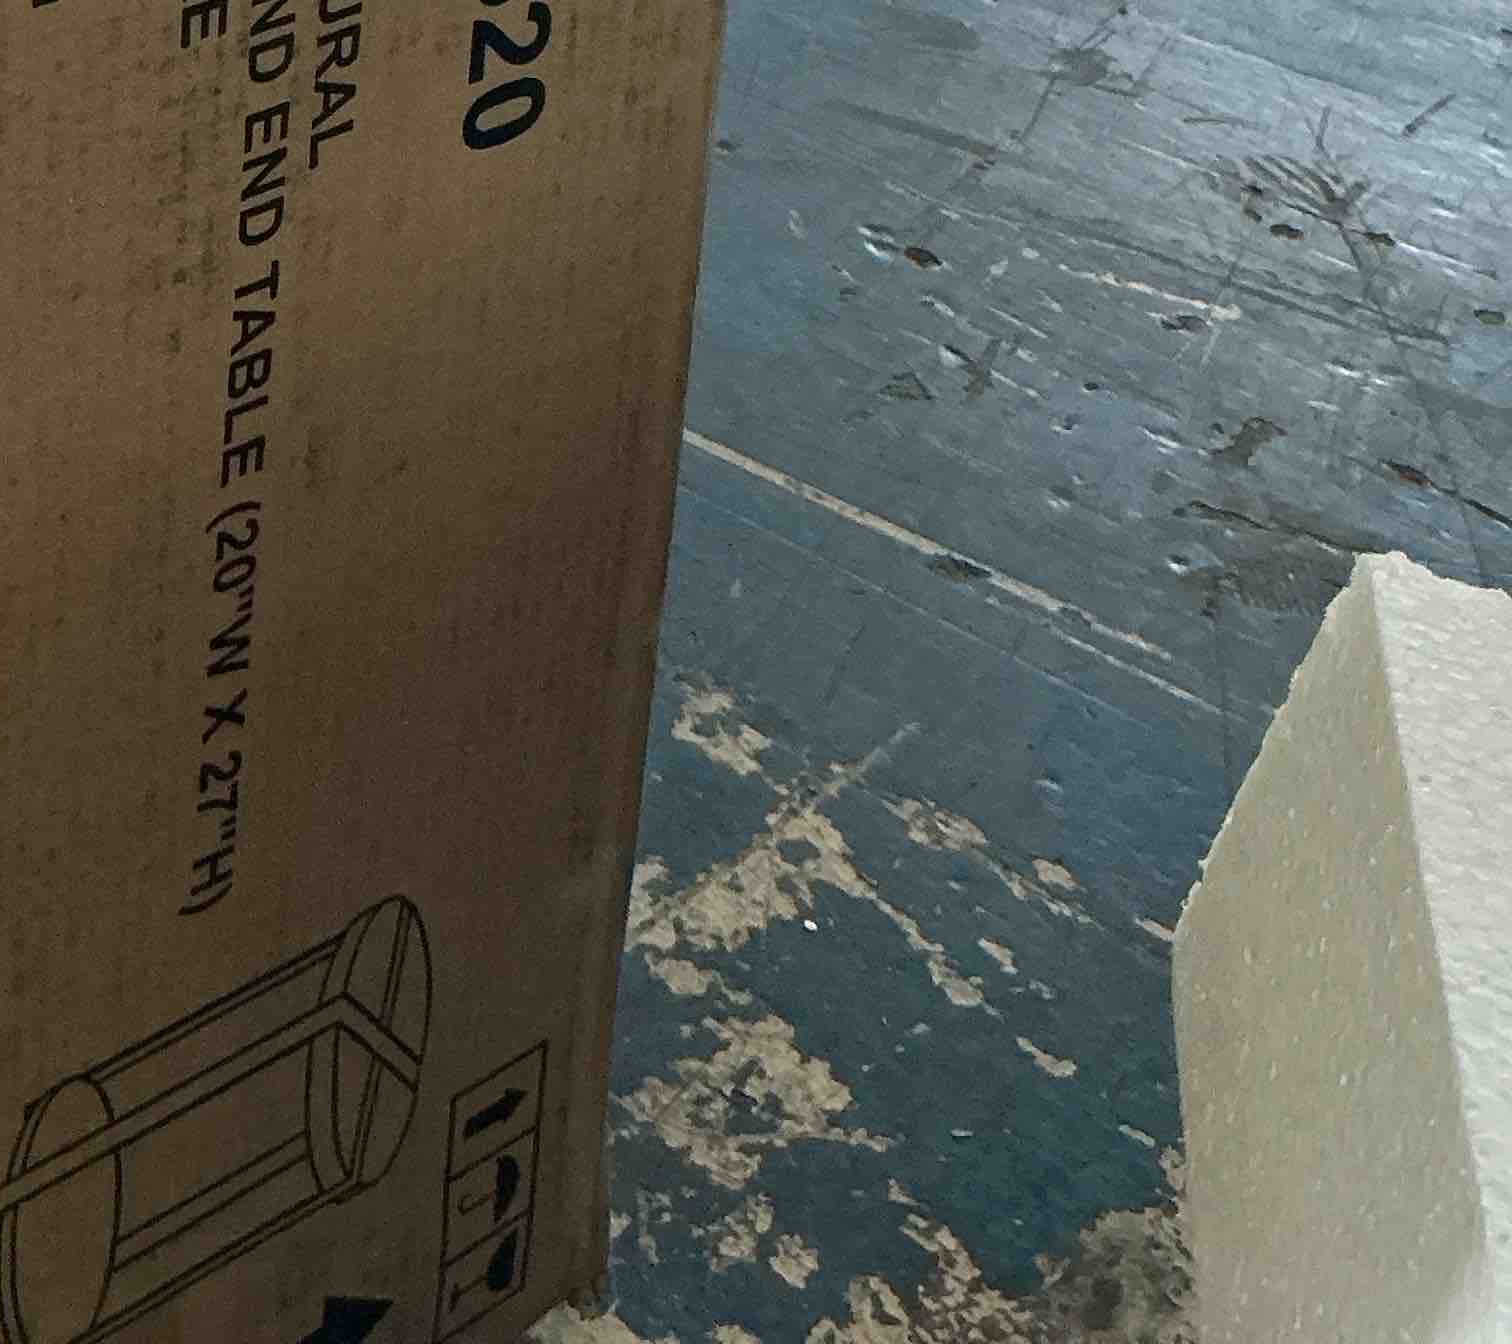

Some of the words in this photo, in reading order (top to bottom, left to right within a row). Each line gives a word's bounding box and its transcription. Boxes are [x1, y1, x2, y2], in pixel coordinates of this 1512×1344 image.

[238, 102, 290, 246] END
[219, 260, 279, 488] TABLE
[204, 501, 261, 678] (20"W
[201, 689, 248, 744] X
[177, 751, 242, 916] 27"H)
